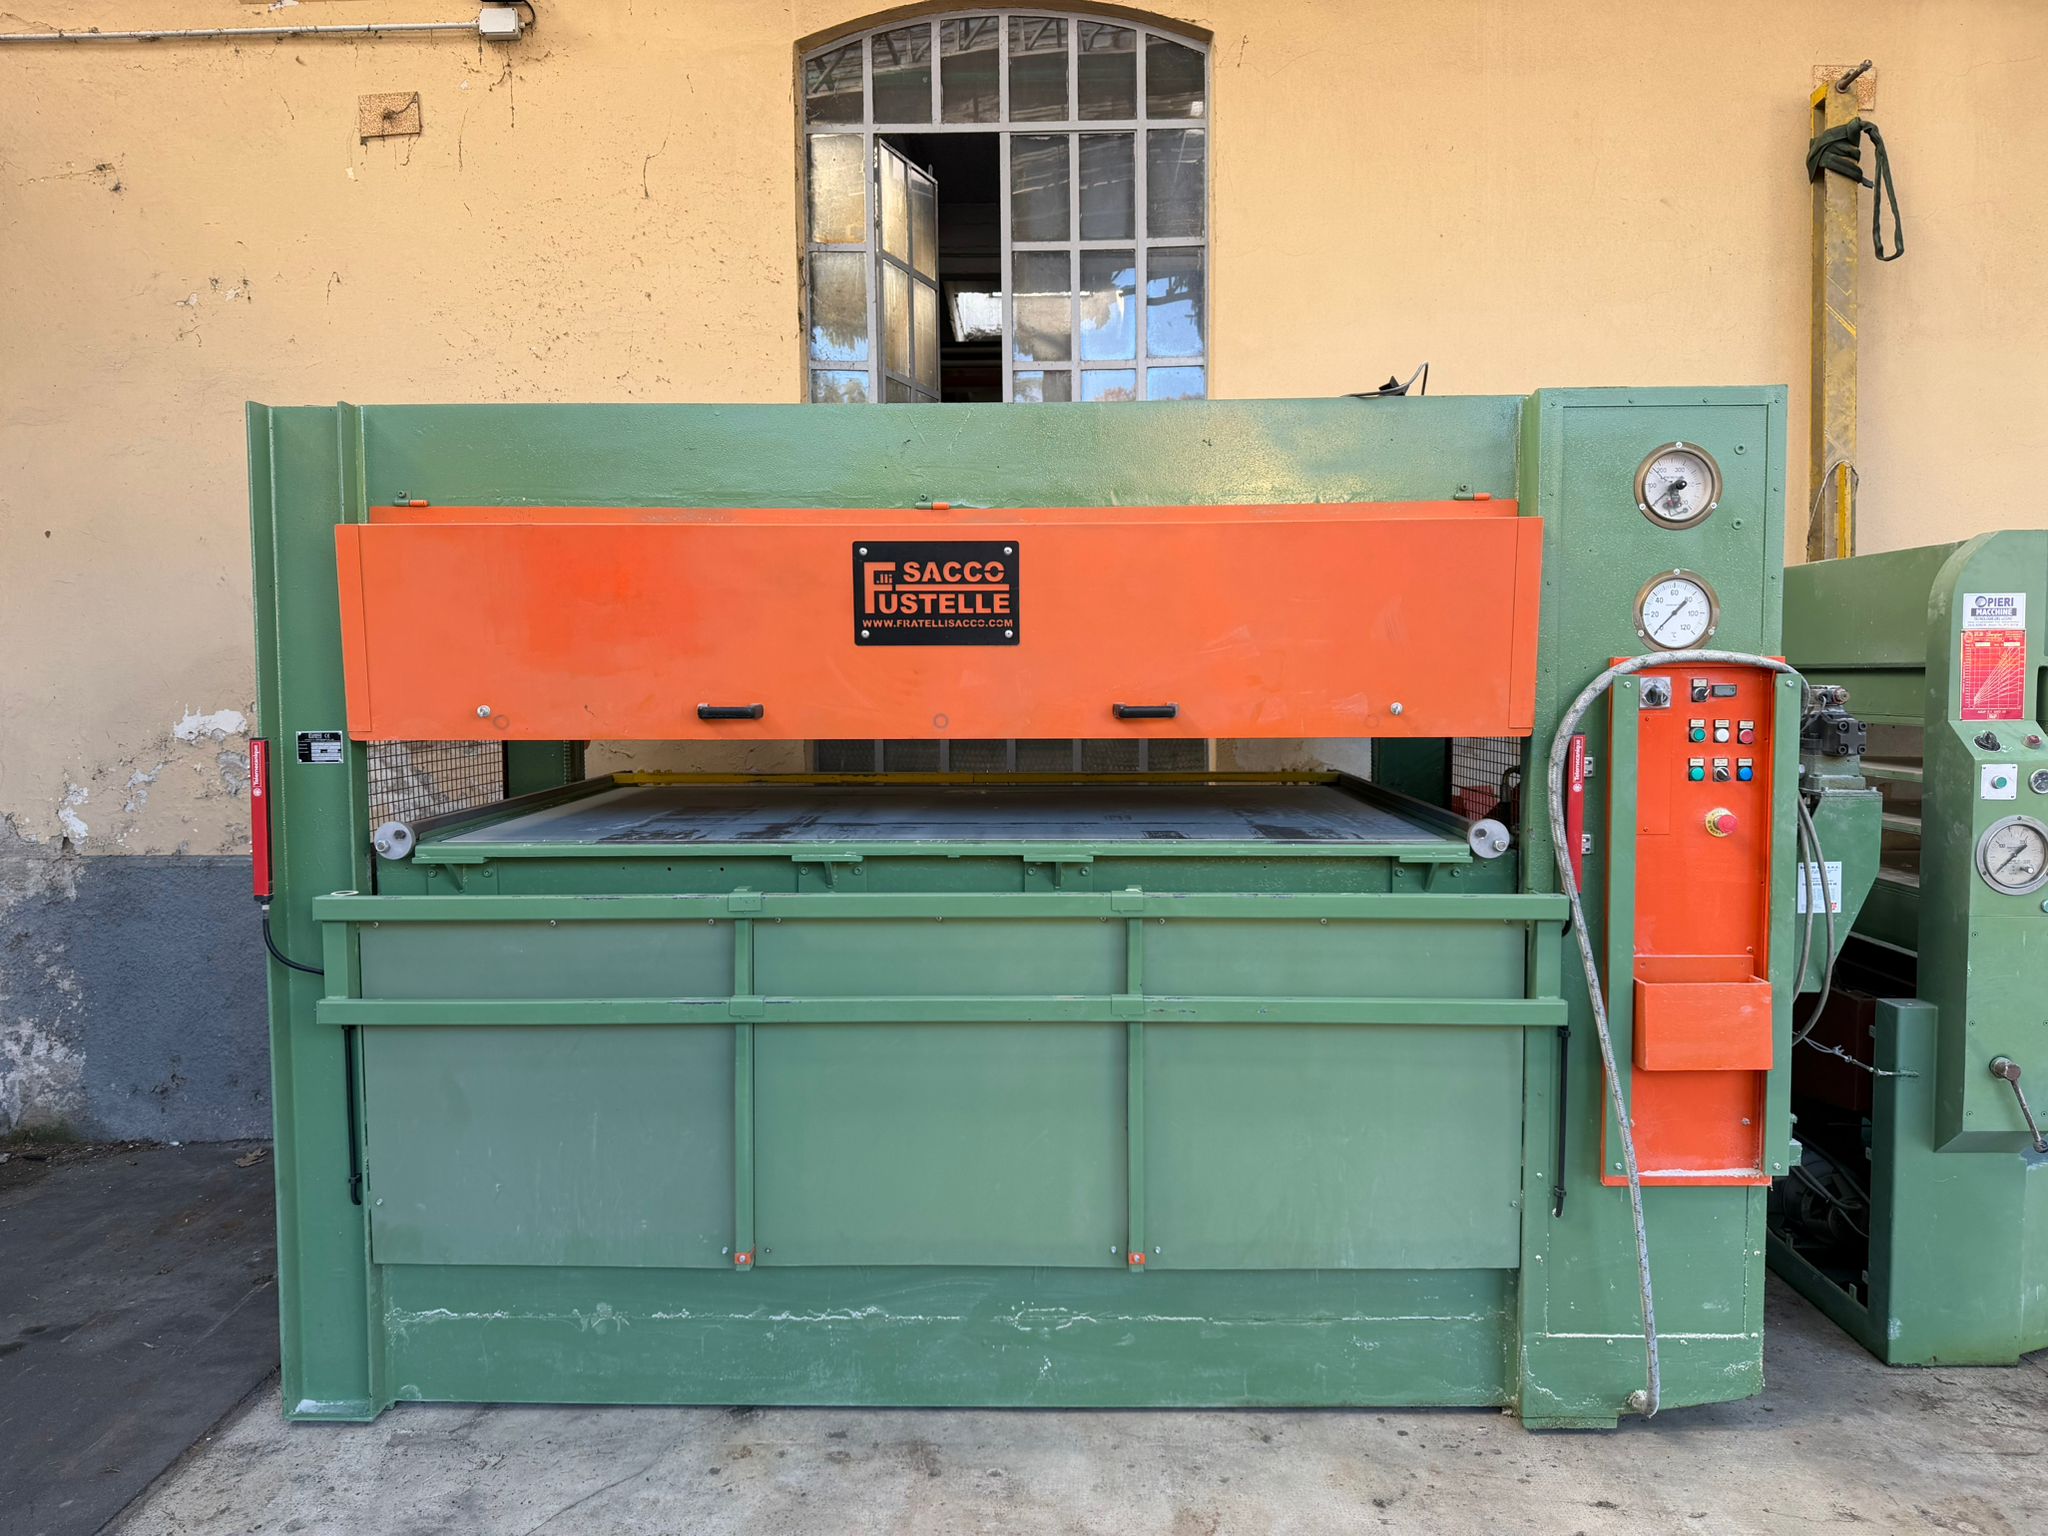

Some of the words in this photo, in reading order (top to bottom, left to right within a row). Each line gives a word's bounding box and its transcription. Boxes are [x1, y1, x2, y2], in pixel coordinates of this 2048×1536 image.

[903, 561, 1005, 583] SACCO
[1987, 597, 2014, 607] PIERI
[1975, 608, 2013, 616] MACCHINE
[862, 619, 1013, 628] WWW.FRATELLISACCO.COM
[1574, 739, 1582, 782] Telemecanique
